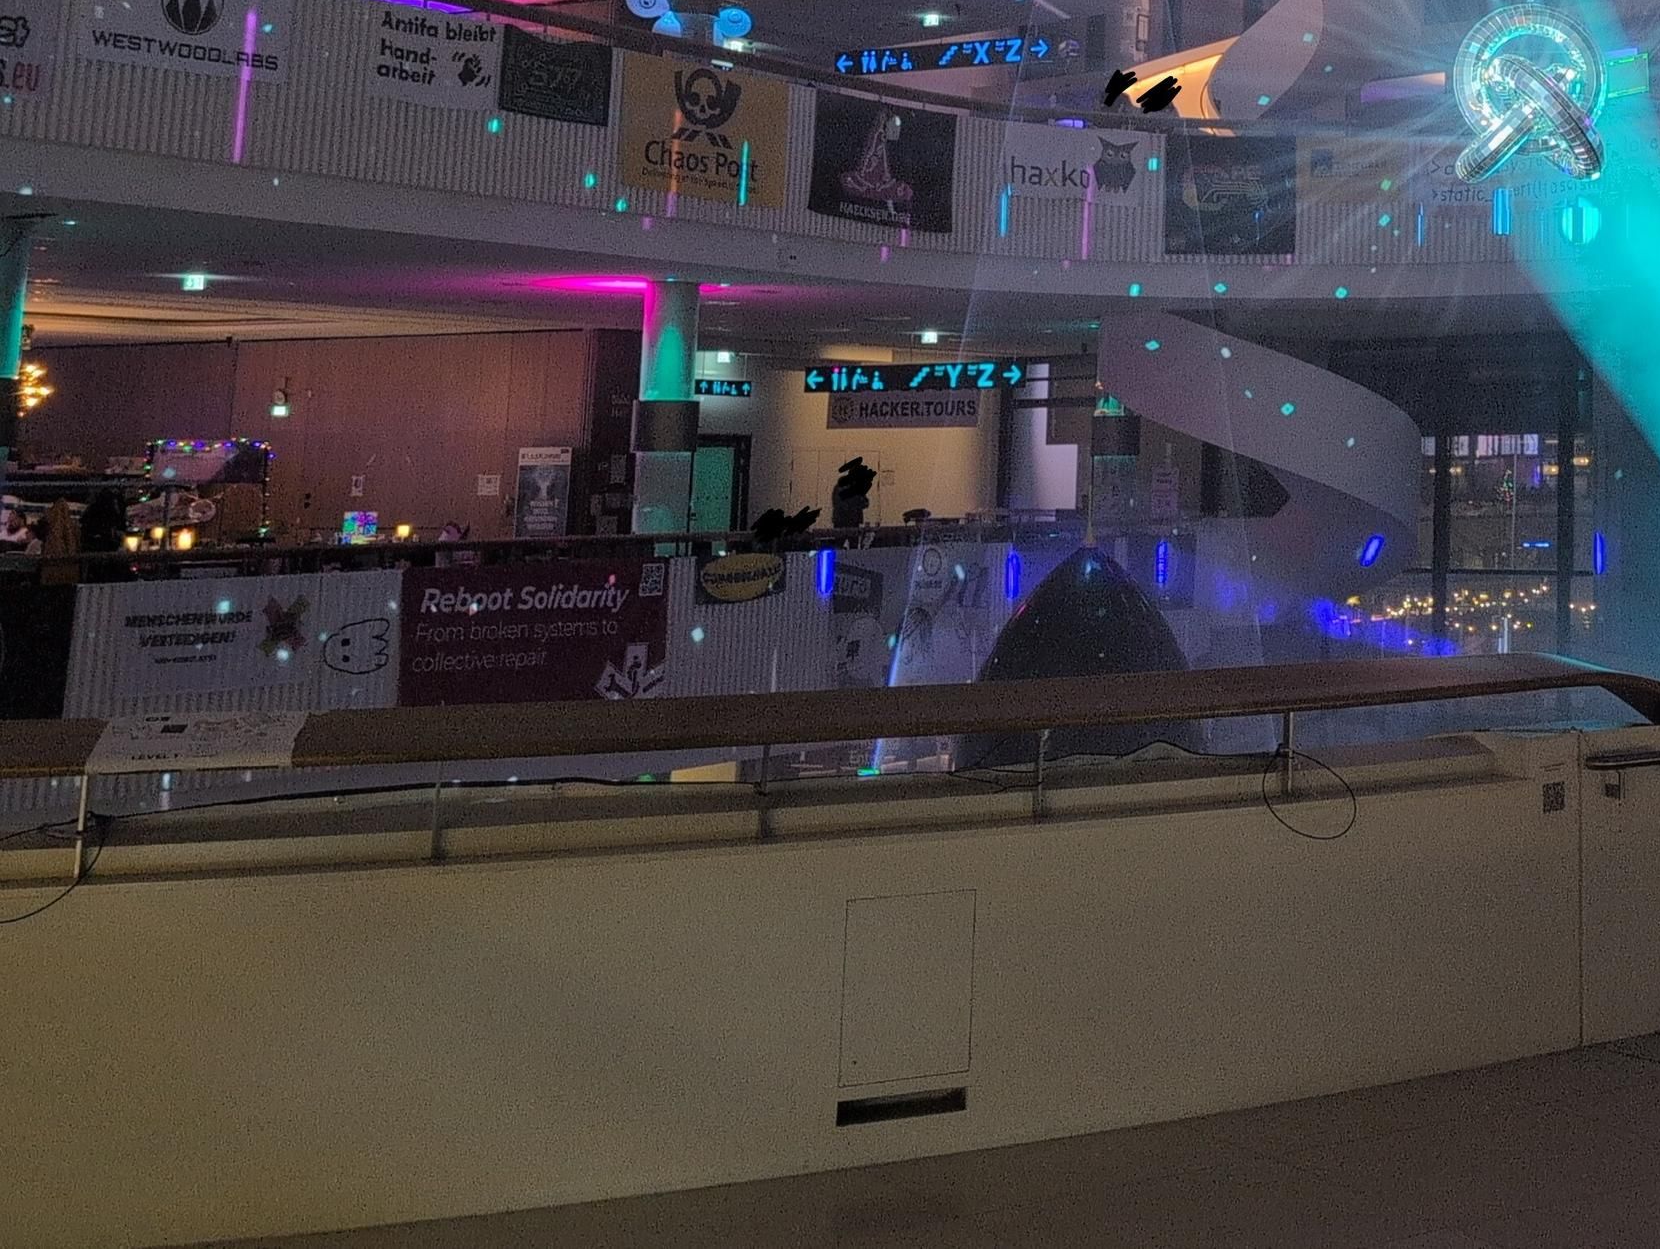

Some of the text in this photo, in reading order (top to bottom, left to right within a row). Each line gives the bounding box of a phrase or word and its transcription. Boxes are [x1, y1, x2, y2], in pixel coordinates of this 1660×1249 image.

[381, 11, 497, 43] Antifa bleibt
[92, 29, 279, 71] WESTWOODLABS
[380, 37, 438, 65] Hand-
[973, 41, 990, 65] X
[1005, 38, 1022, 63] Z
[376, 61, 436, 86] arbeit
[643, 139, 709, 173] Chaos
[715, 152, 759, 183] Pot
[1010, 155, 1092, 190] haxko
[946, 364, 961, 388] Y
[976, 363, 995, 388] Z
[858, 399, 978, 419] HACKER.TOURS
[421, 584, 629, 613] Reboot Solidarity
[415, 617, 619, 643] From broken systems to
[411, 649, 547, 673] collective repair
